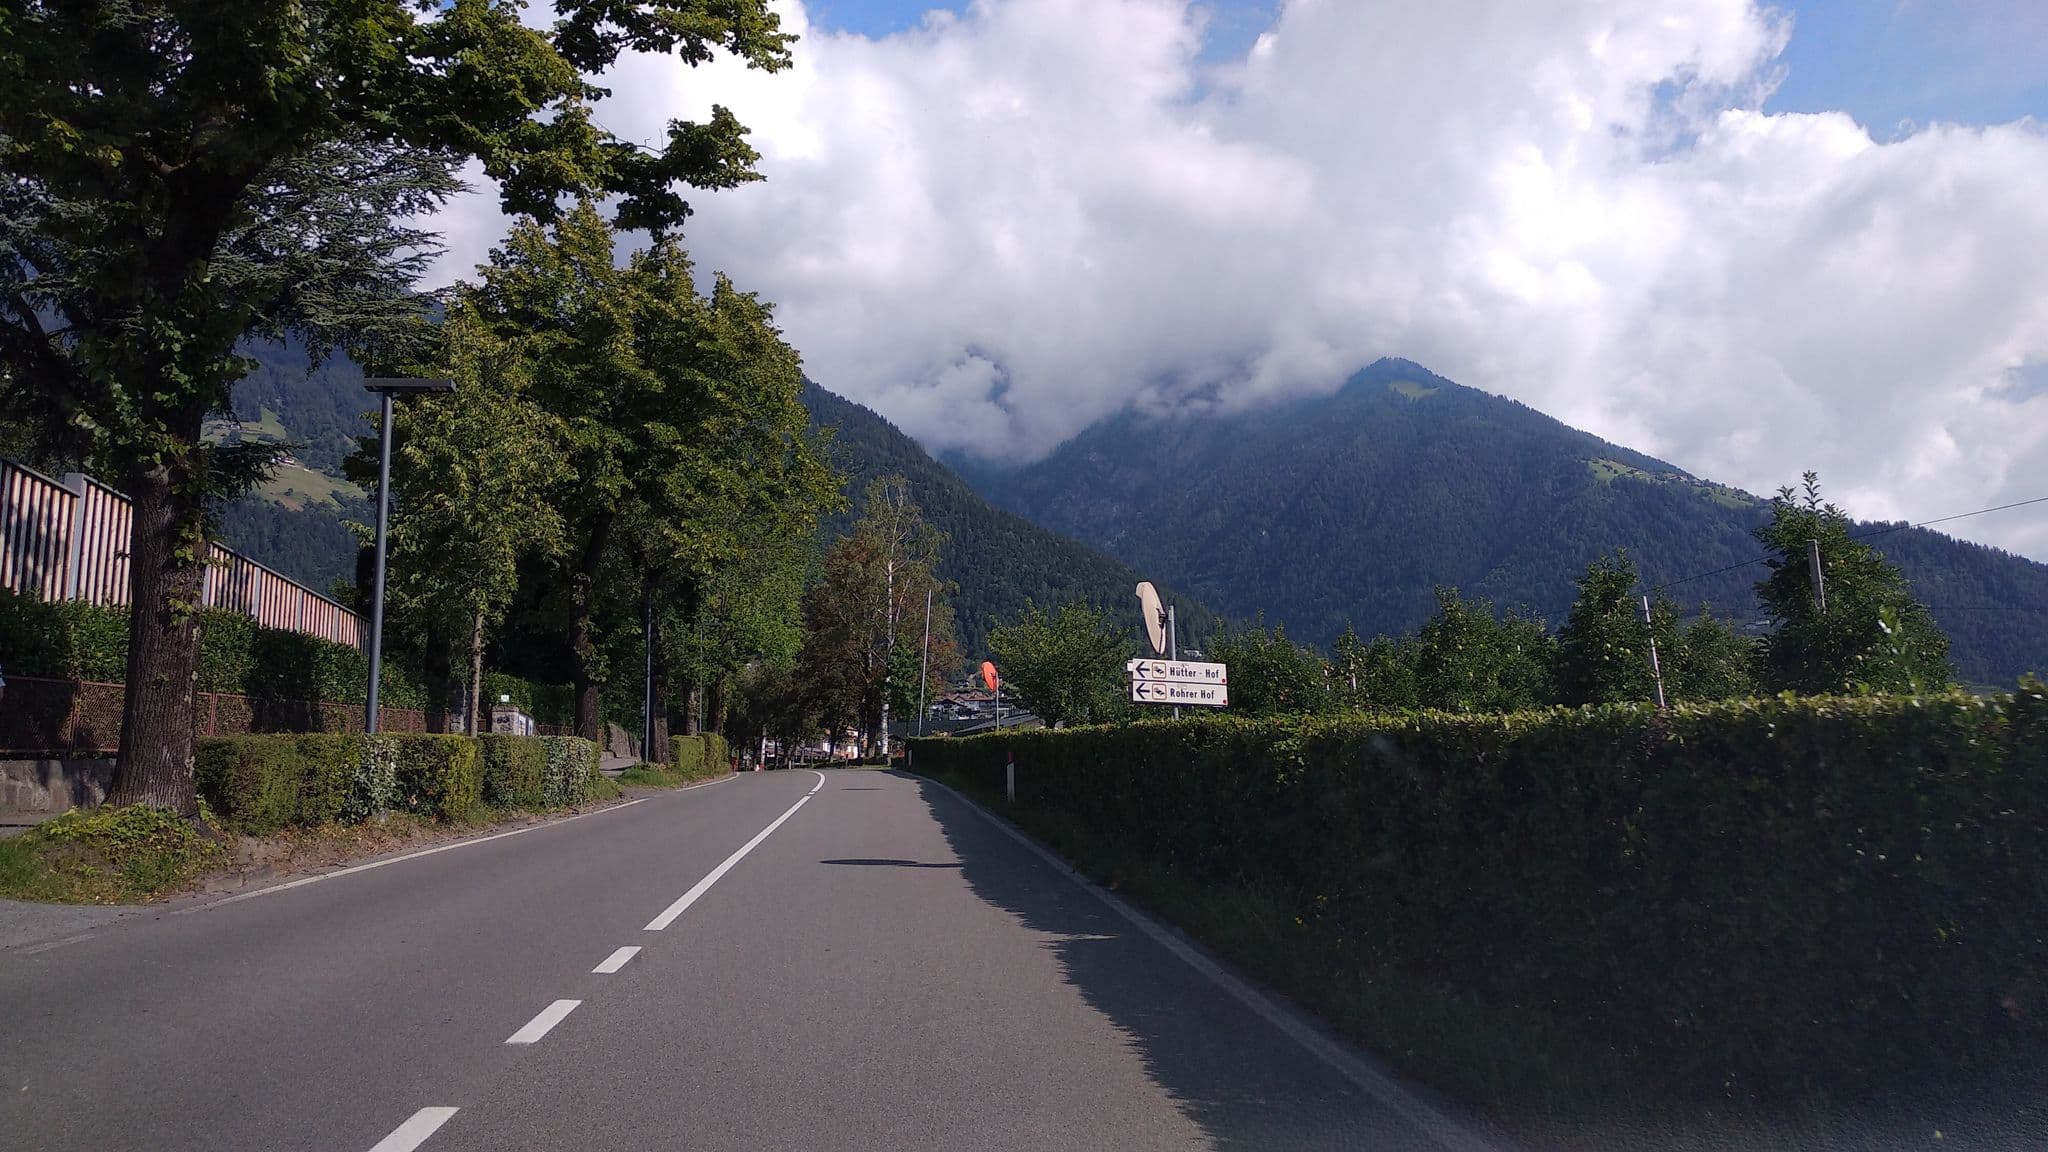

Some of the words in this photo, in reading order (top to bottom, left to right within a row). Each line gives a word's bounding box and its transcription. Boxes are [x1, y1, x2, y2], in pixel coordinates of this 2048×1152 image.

[1169, 666, 1196, 678] Hütter
[1205, 668, 1219, 679] Hof
[1170, 688, 1197, 699] Rohrer
[1200, 689, 1215, 699] Hof
